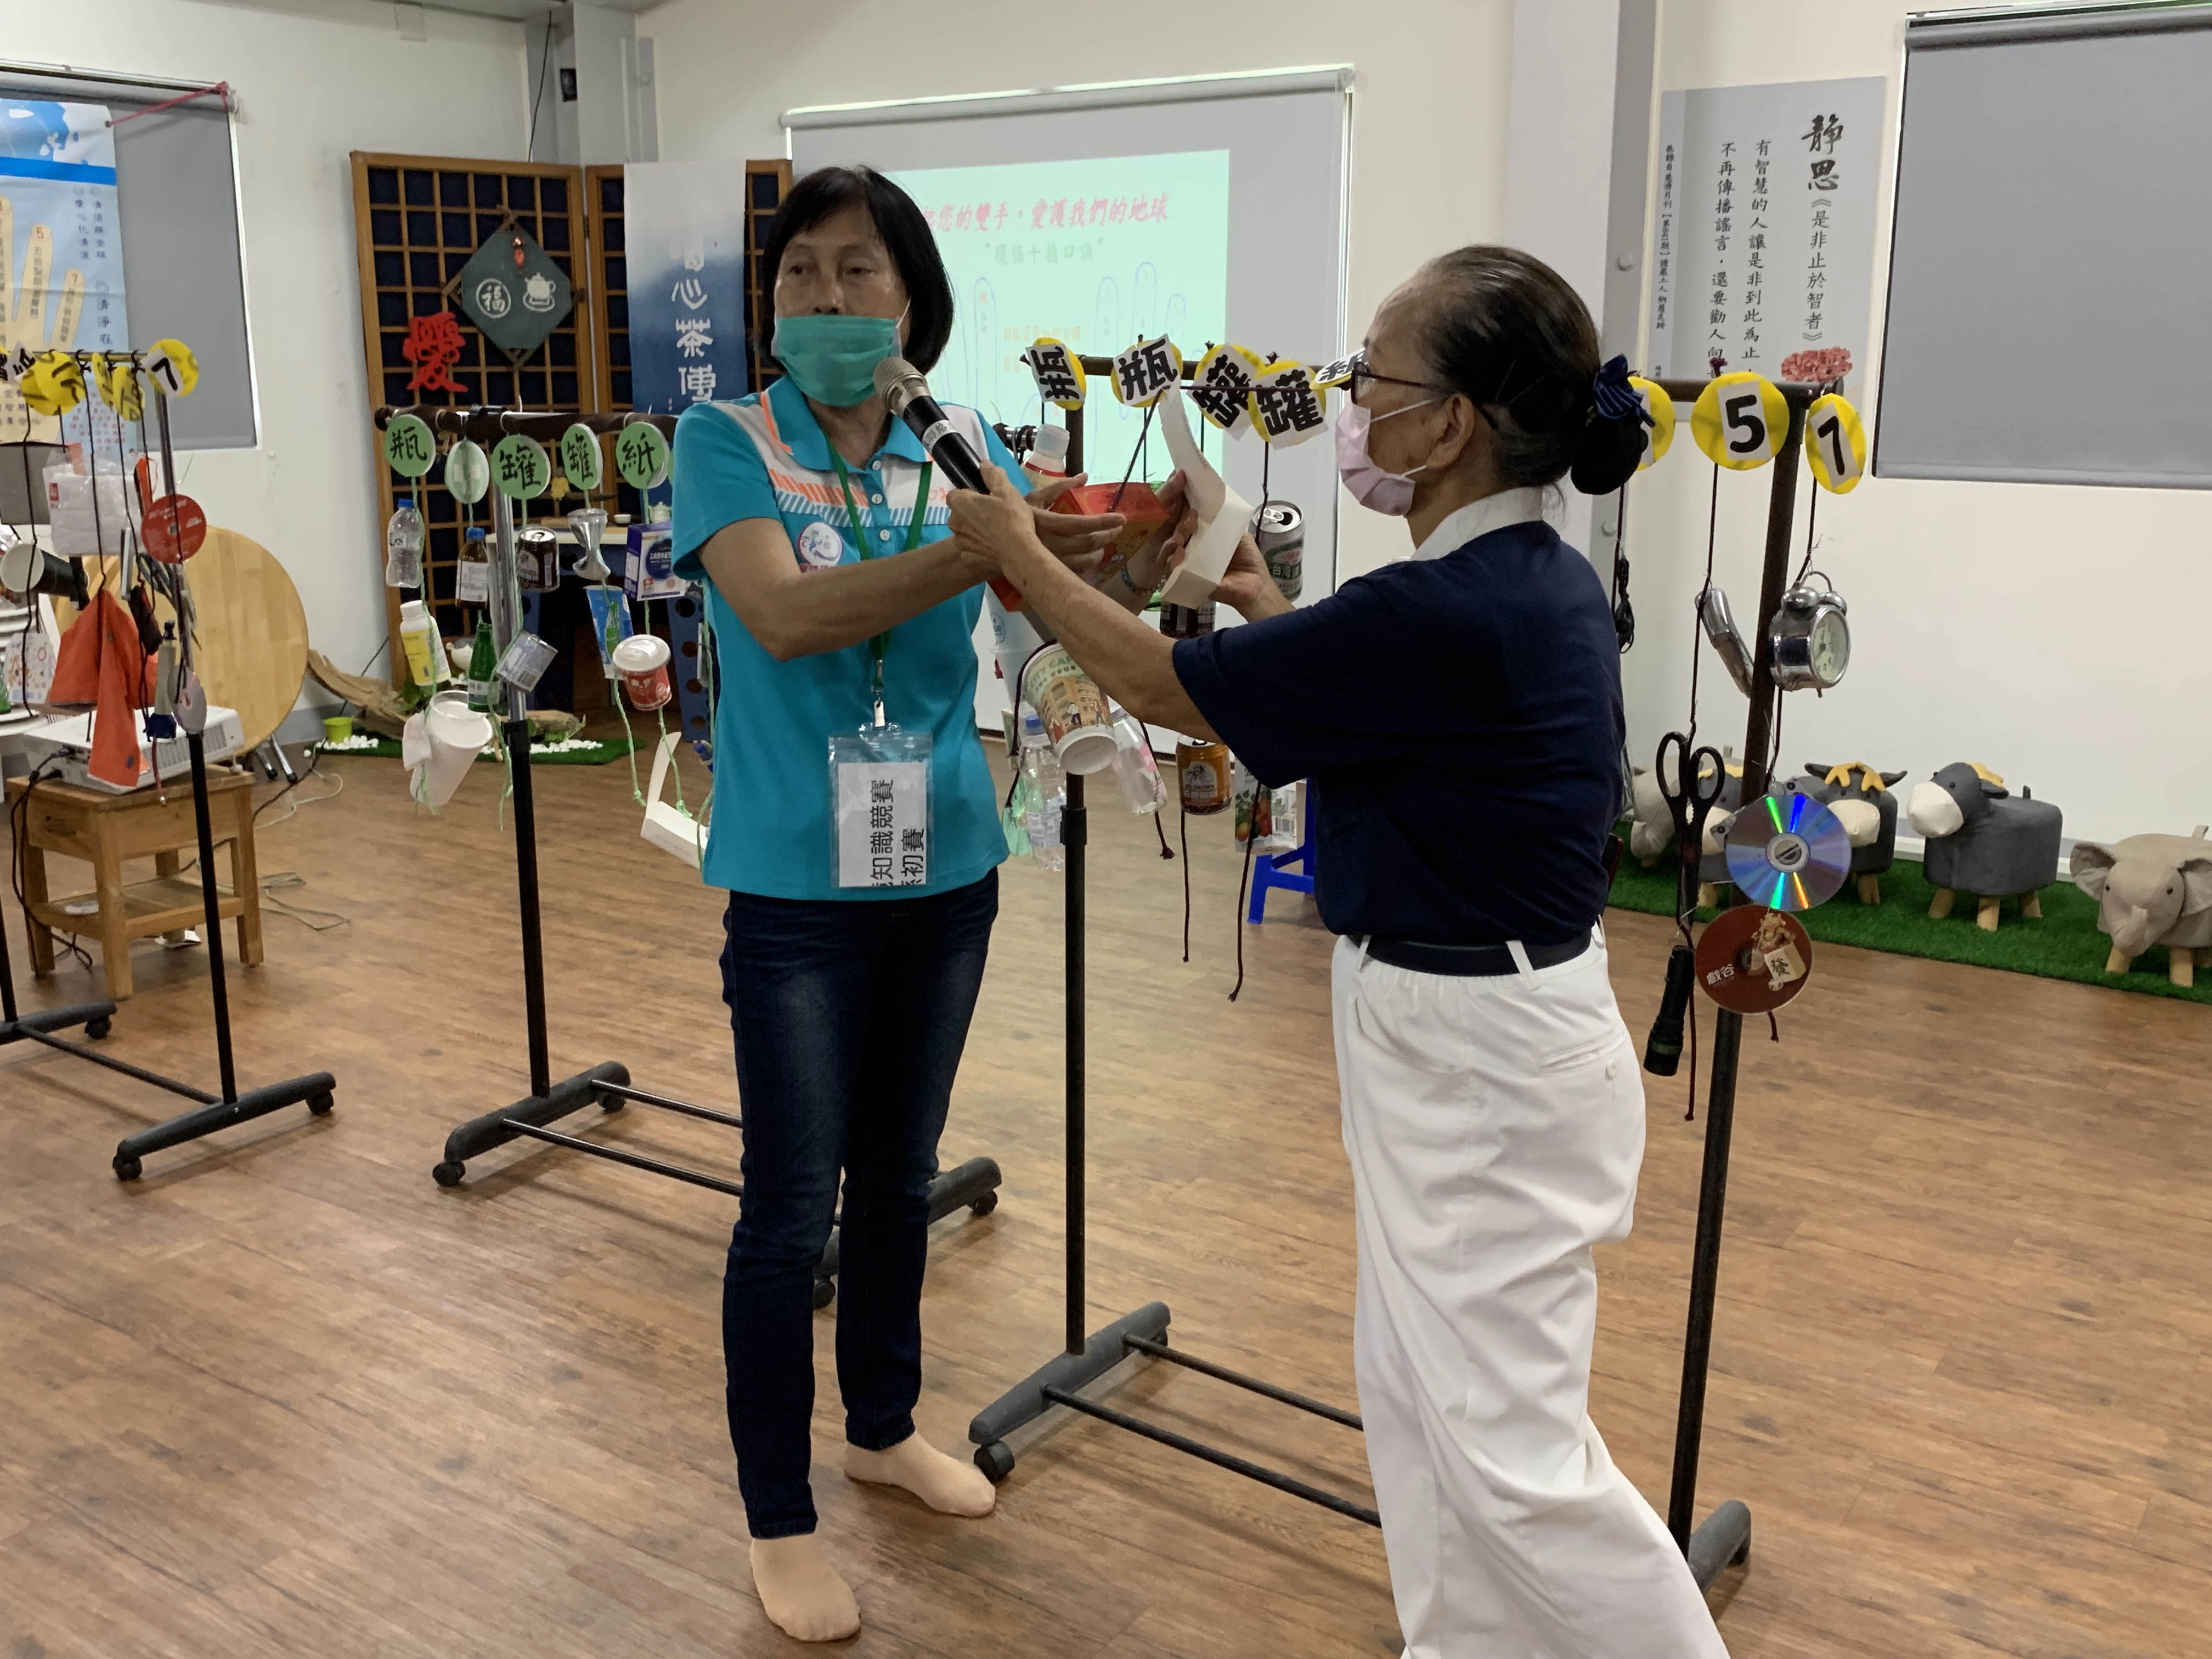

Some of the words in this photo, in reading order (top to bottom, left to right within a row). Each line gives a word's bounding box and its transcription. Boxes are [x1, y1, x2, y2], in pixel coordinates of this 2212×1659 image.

[37, 227, 44, 240] 5
[482, 285, 503, 311] 福
[1118, 338, 1178, 400] 瓶
[1256, 369, 1323, 436] 罐
[1725, 394, 1765, 454] 5
[390, 426, 427, 461] 瓶
[567, 433, 594, 482] 罐
[623, 432, 655, 476] 紙
[499, 444, 541, 490] 罐
[870, 780, 894, 887] 知識競賽
[1771, 957, 1791, 977] 發
